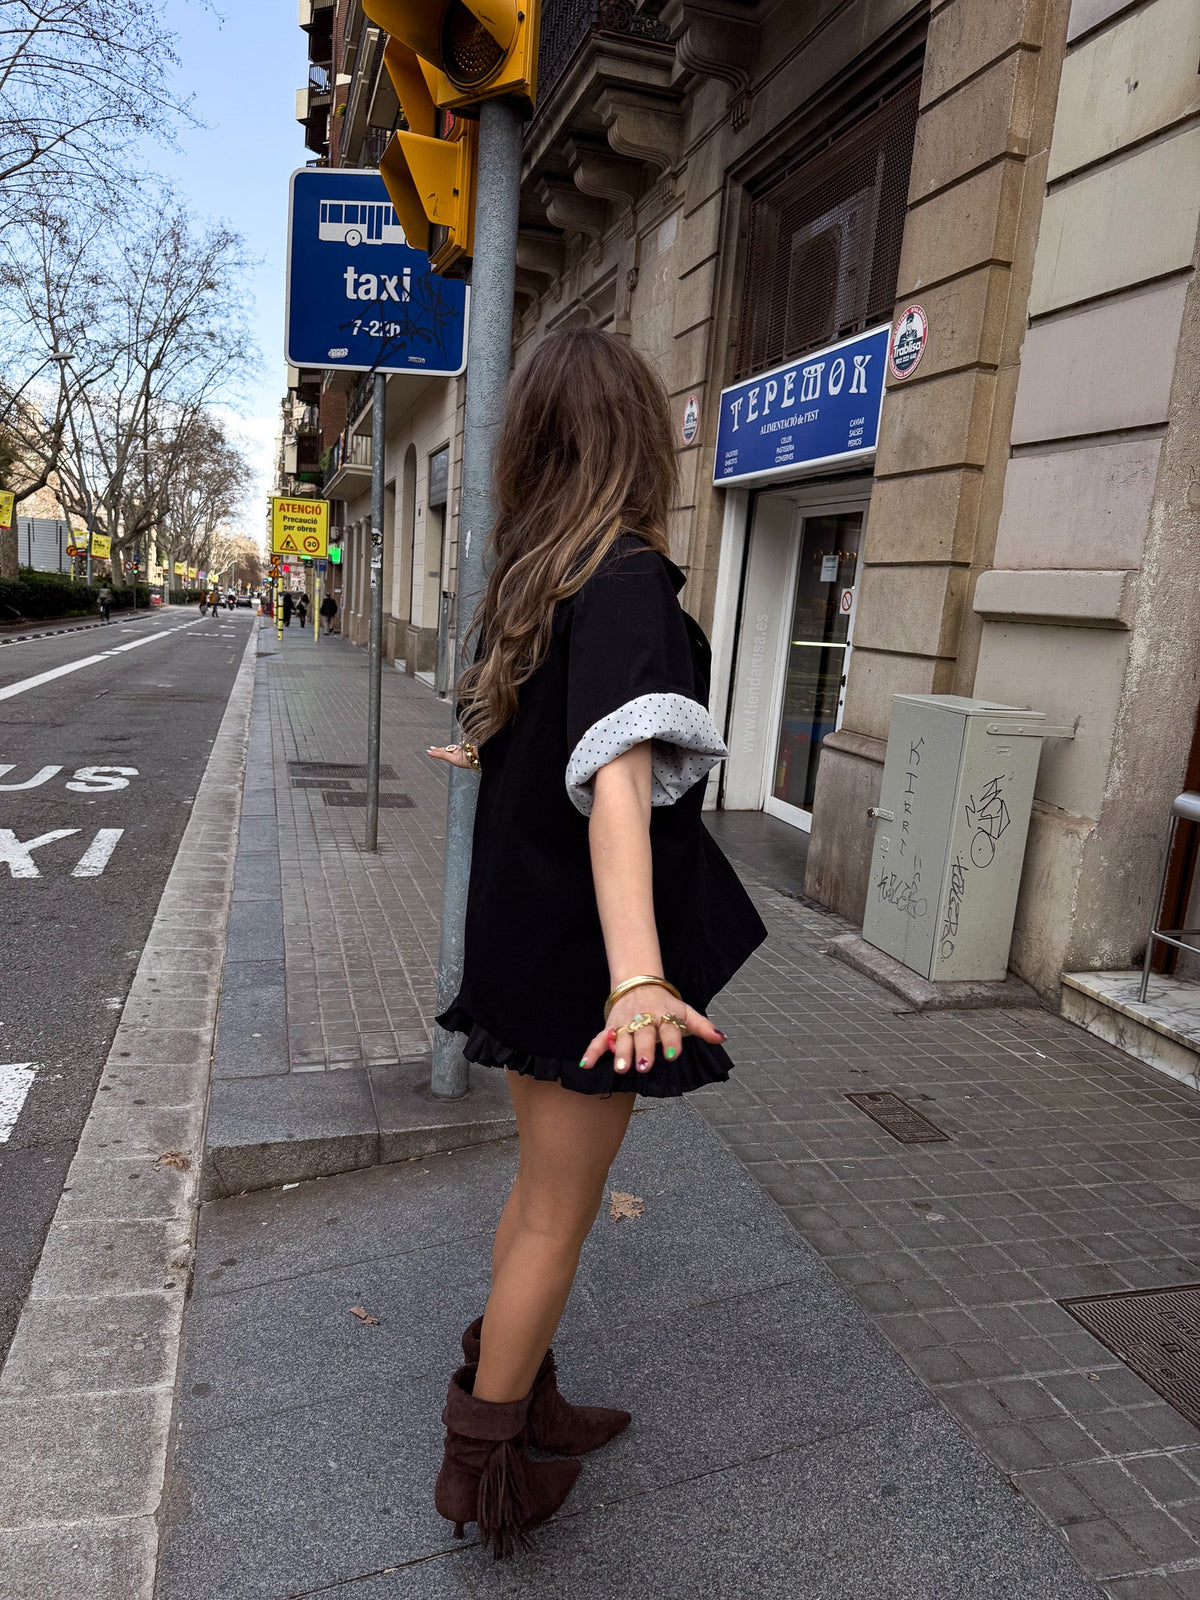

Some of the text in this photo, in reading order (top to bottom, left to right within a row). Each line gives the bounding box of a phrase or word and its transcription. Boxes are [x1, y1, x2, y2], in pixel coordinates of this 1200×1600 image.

[343, 266, 411, 302] taxi
[893, 341, 922, 358] Trablisa
[760, 413, 798, 435] ALIMENTACIÓ
[849, 417, 865, 427] CAVIAR
[848, 427, 864, 438] SALSES
[279, 502, 322, 516] ATENCIÓ
[282, 515, 318, 525] Precaució
[296, 524, 317, 533] obres
[743, 613, 768, 754] www.tiendarusa.es
